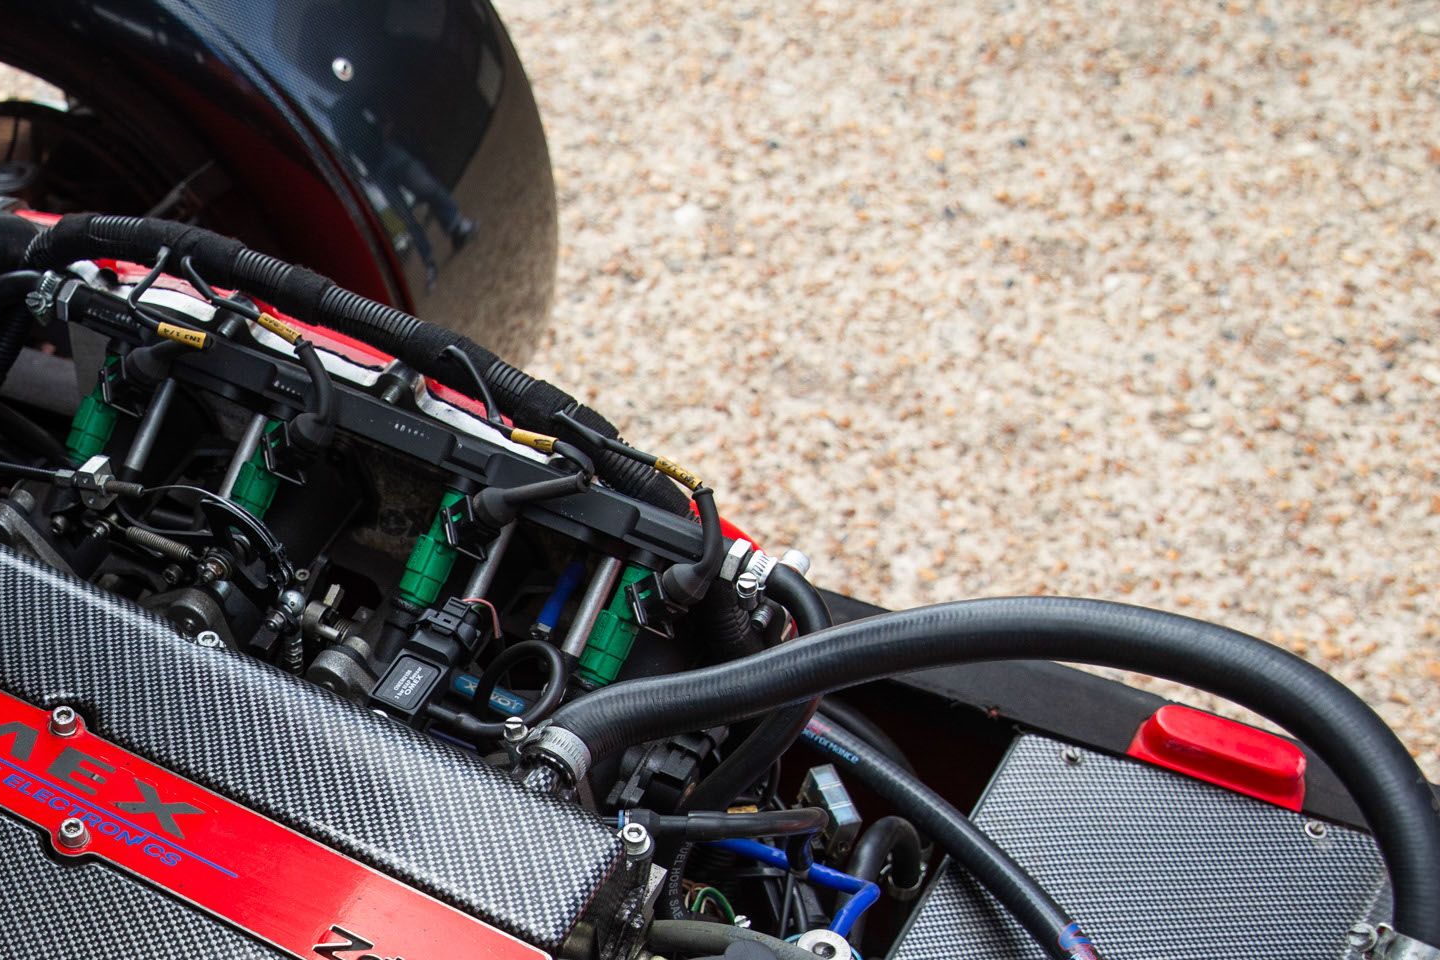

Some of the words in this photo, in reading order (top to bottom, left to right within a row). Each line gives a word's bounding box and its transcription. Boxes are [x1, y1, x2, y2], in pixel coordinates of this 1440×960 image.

[405, 674, 422, 695] OMEX
[2, 773, 182, 867] ELECTRONICS
[673, 841, 692, 866] FUEL
[668, 867, 680, 896] HOSE
[669, 900, 683, 920] SAE
